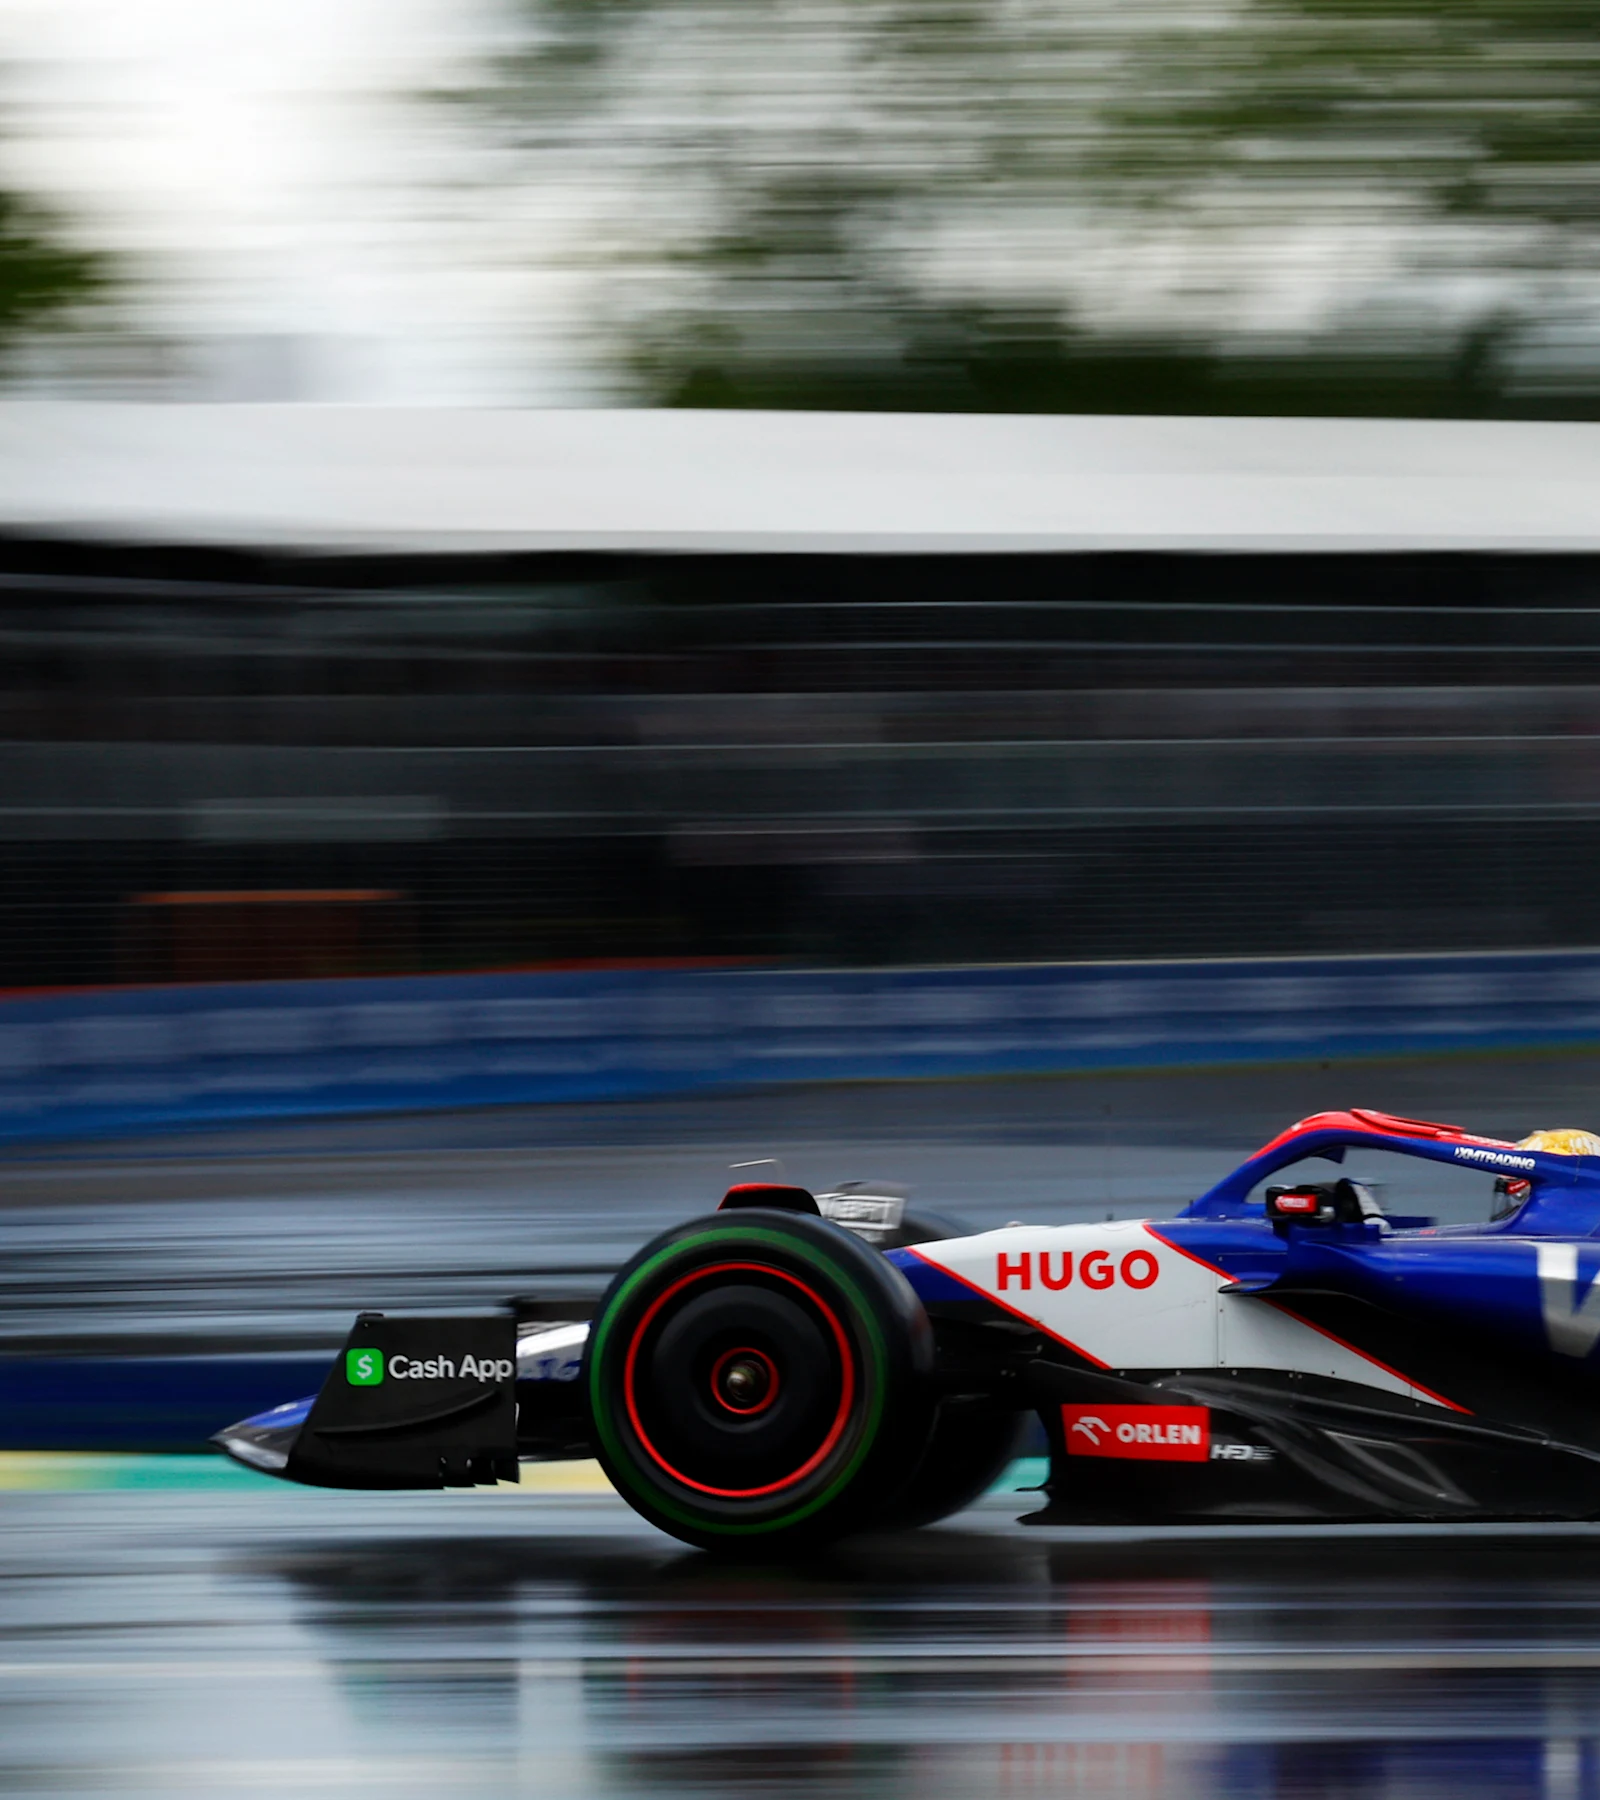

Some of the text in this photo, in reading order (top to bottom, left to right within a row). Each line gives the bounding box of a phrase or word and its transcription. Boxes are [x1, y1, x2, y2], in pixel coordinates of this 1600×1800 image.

[997, 1249, 1160, 1291] HUGO
[388, 1354, 455, 1379] Cash
[459, 1354, 514, 1382] App
[1116, 1423, 1201, 1444] ORLEN
